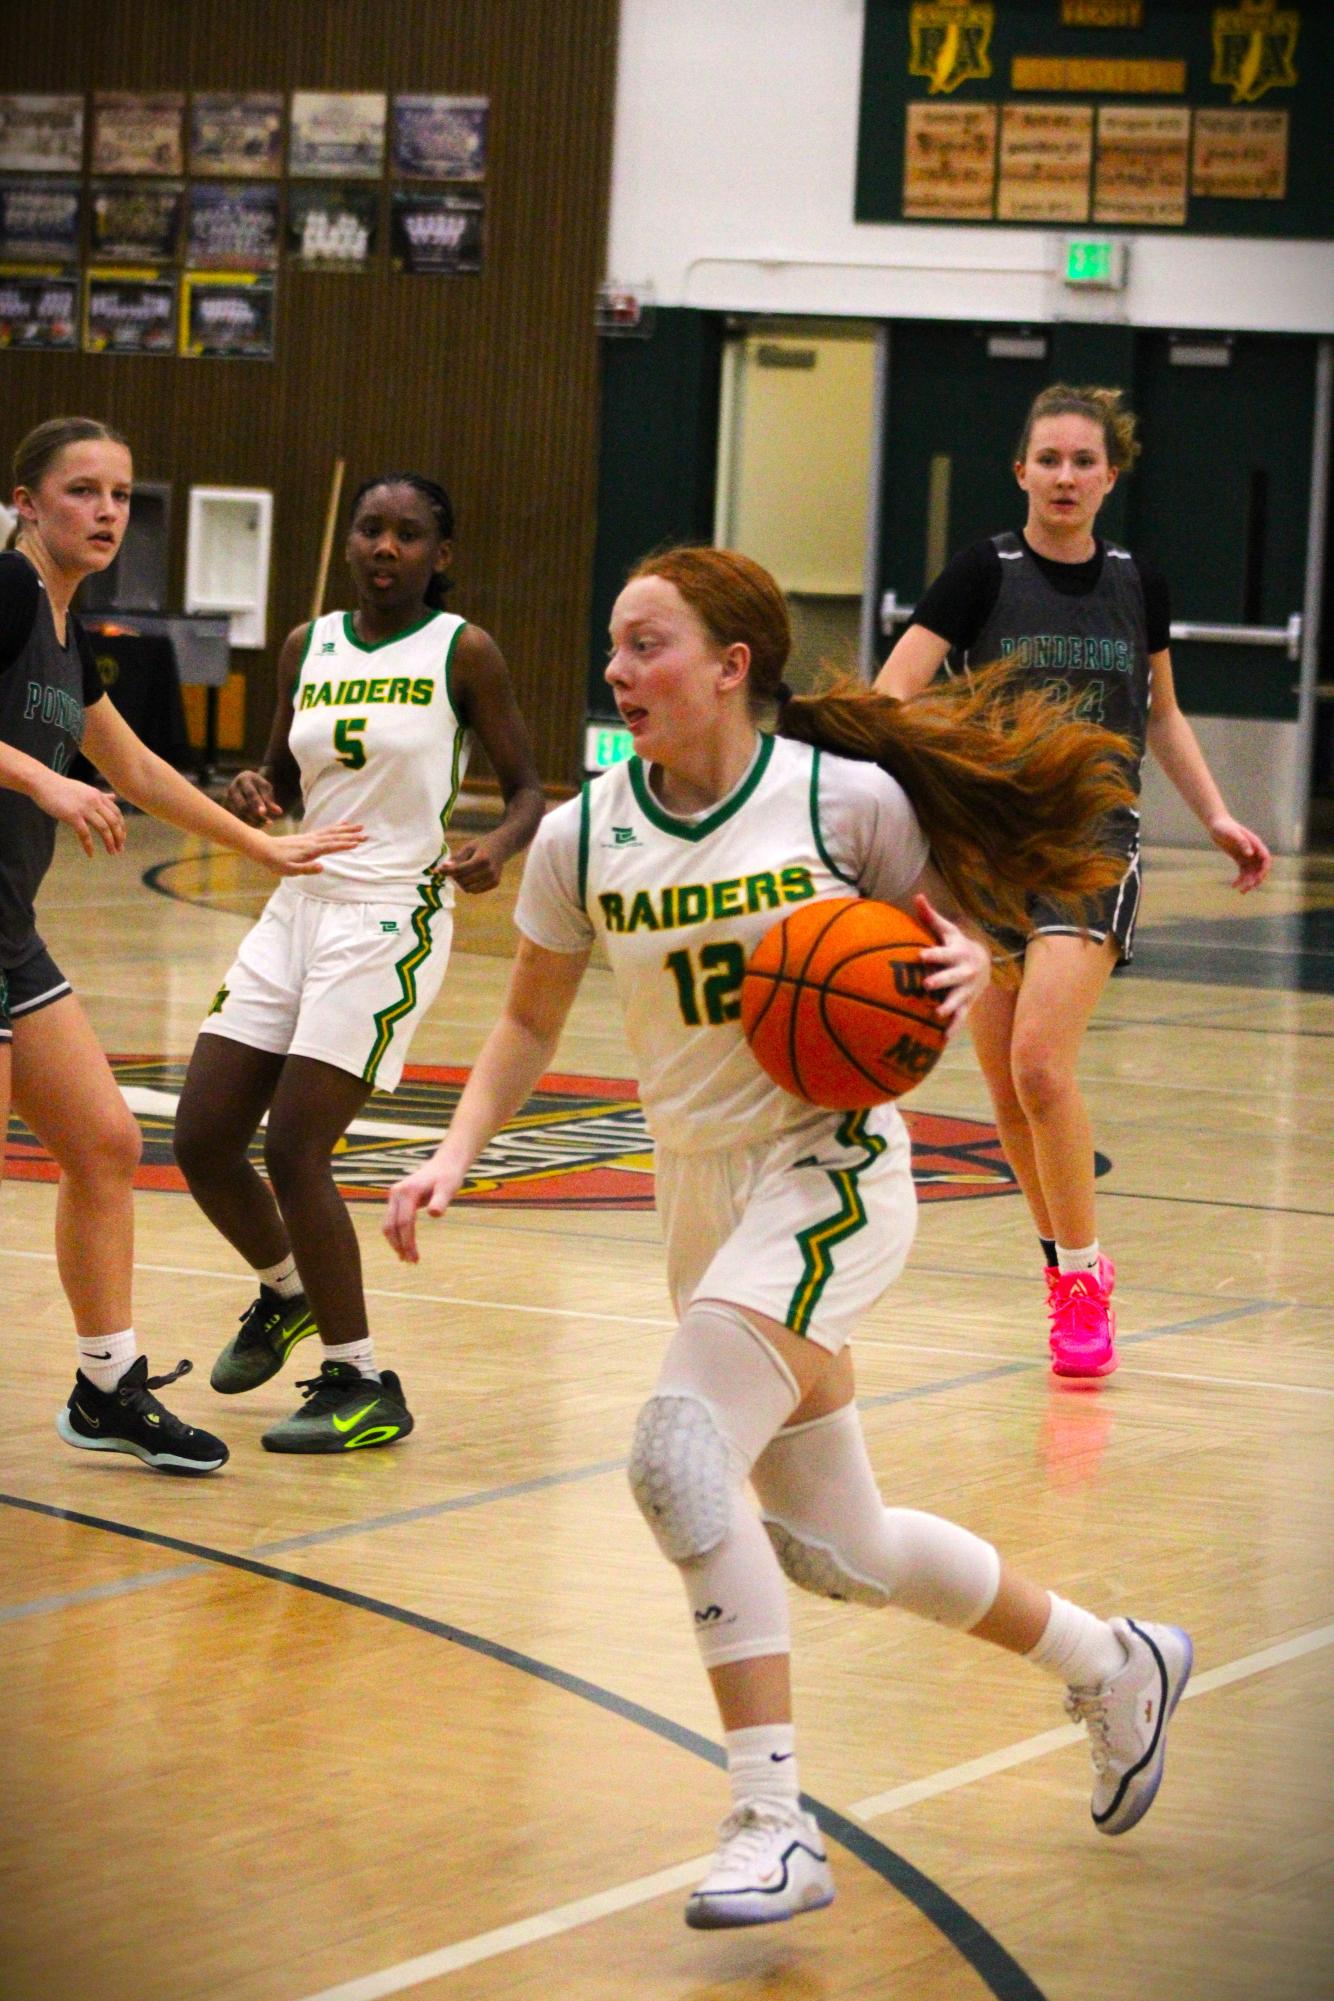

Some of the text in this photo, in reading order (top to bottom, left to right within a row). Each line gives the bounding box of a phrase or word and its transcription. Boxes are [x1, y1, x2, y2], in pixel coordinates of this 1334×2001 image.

[299, 677, 435, 712] RAIDERS
[332, 717, 369, 770] 5
[598, 866, 817, 934] RAIDERS
[663, 940, 746, 1027] 12
